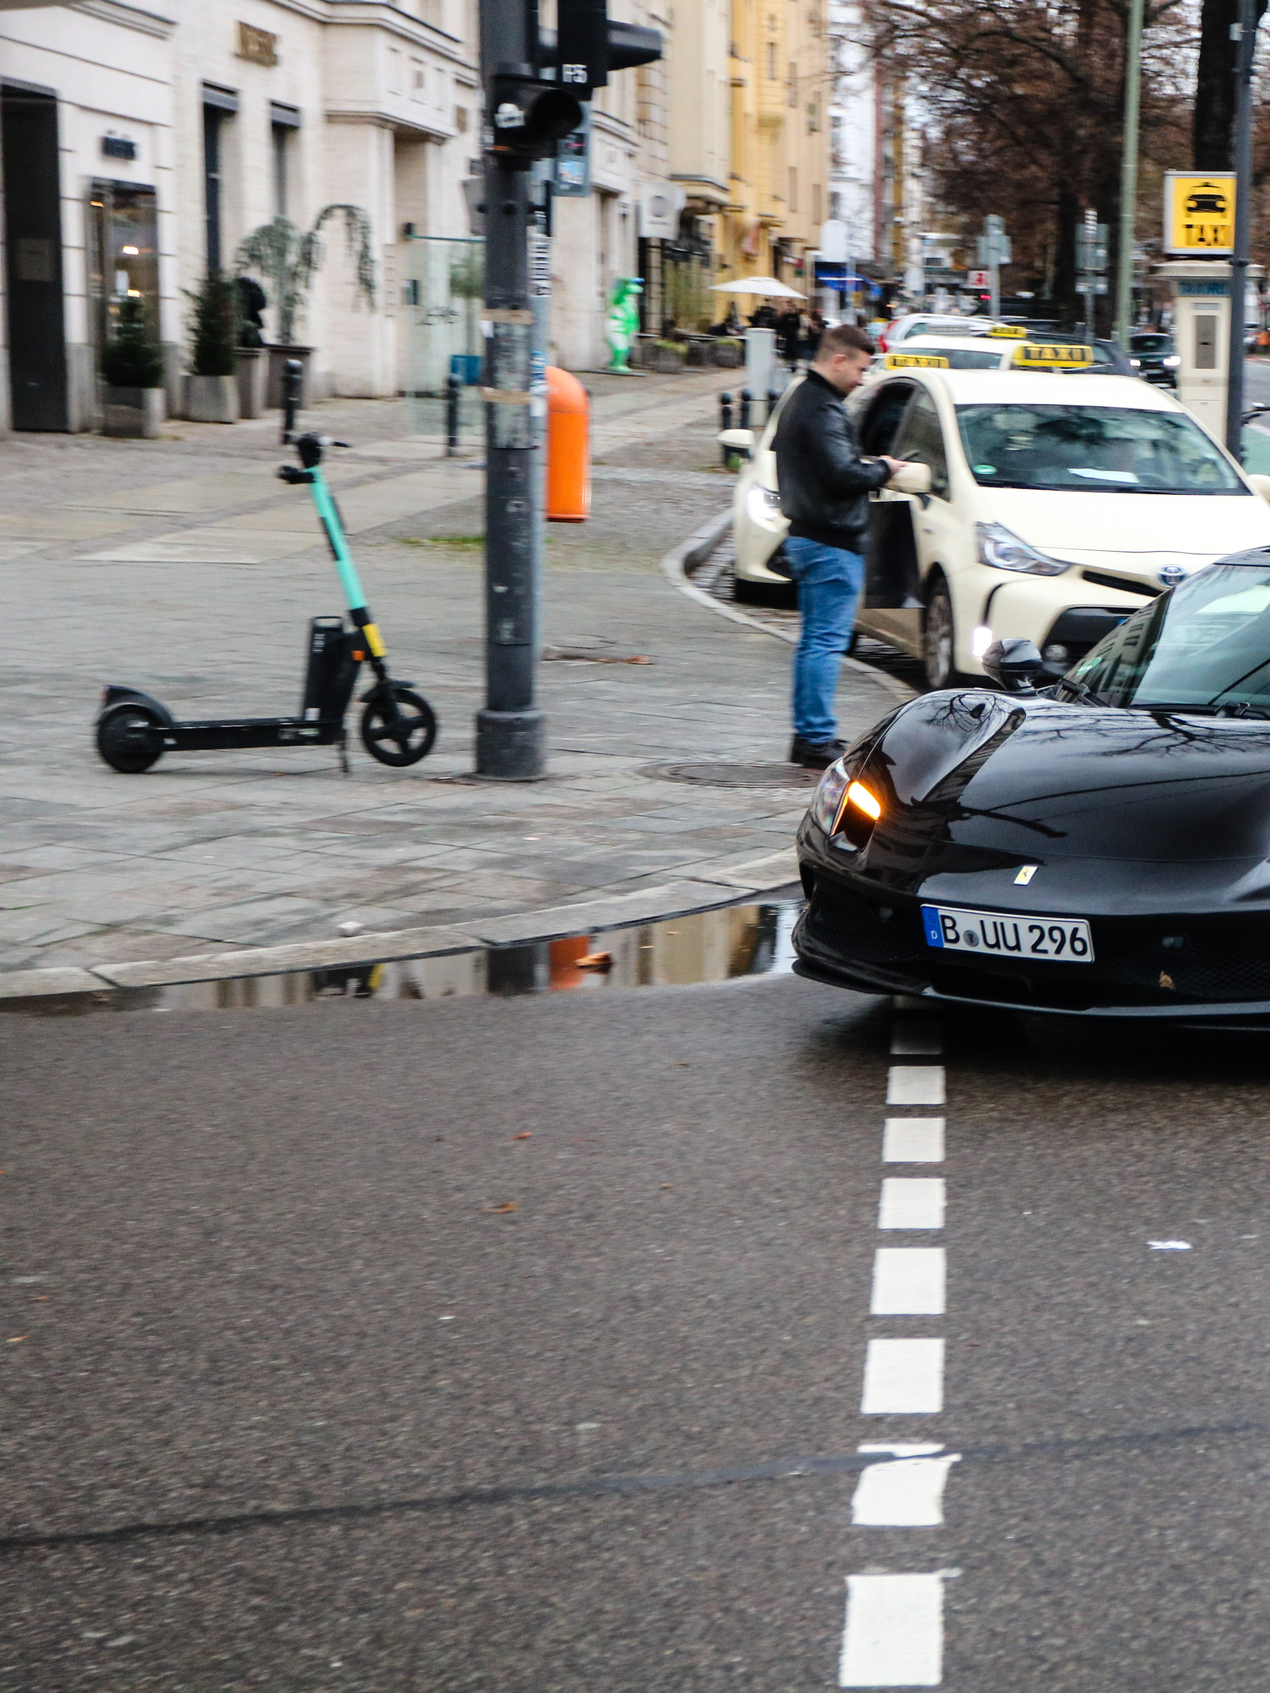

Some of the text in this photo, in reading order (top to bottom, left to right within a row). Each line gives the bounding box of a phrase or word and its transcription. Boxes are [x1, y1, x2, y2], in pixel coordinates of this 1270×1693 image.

[1182, 224, 1232, 246] TAXI
[1025, 346, 1084, 360] TAXI
[930, 930, 938, 940] D
[939, 914, 1088, 957] B UU 296
